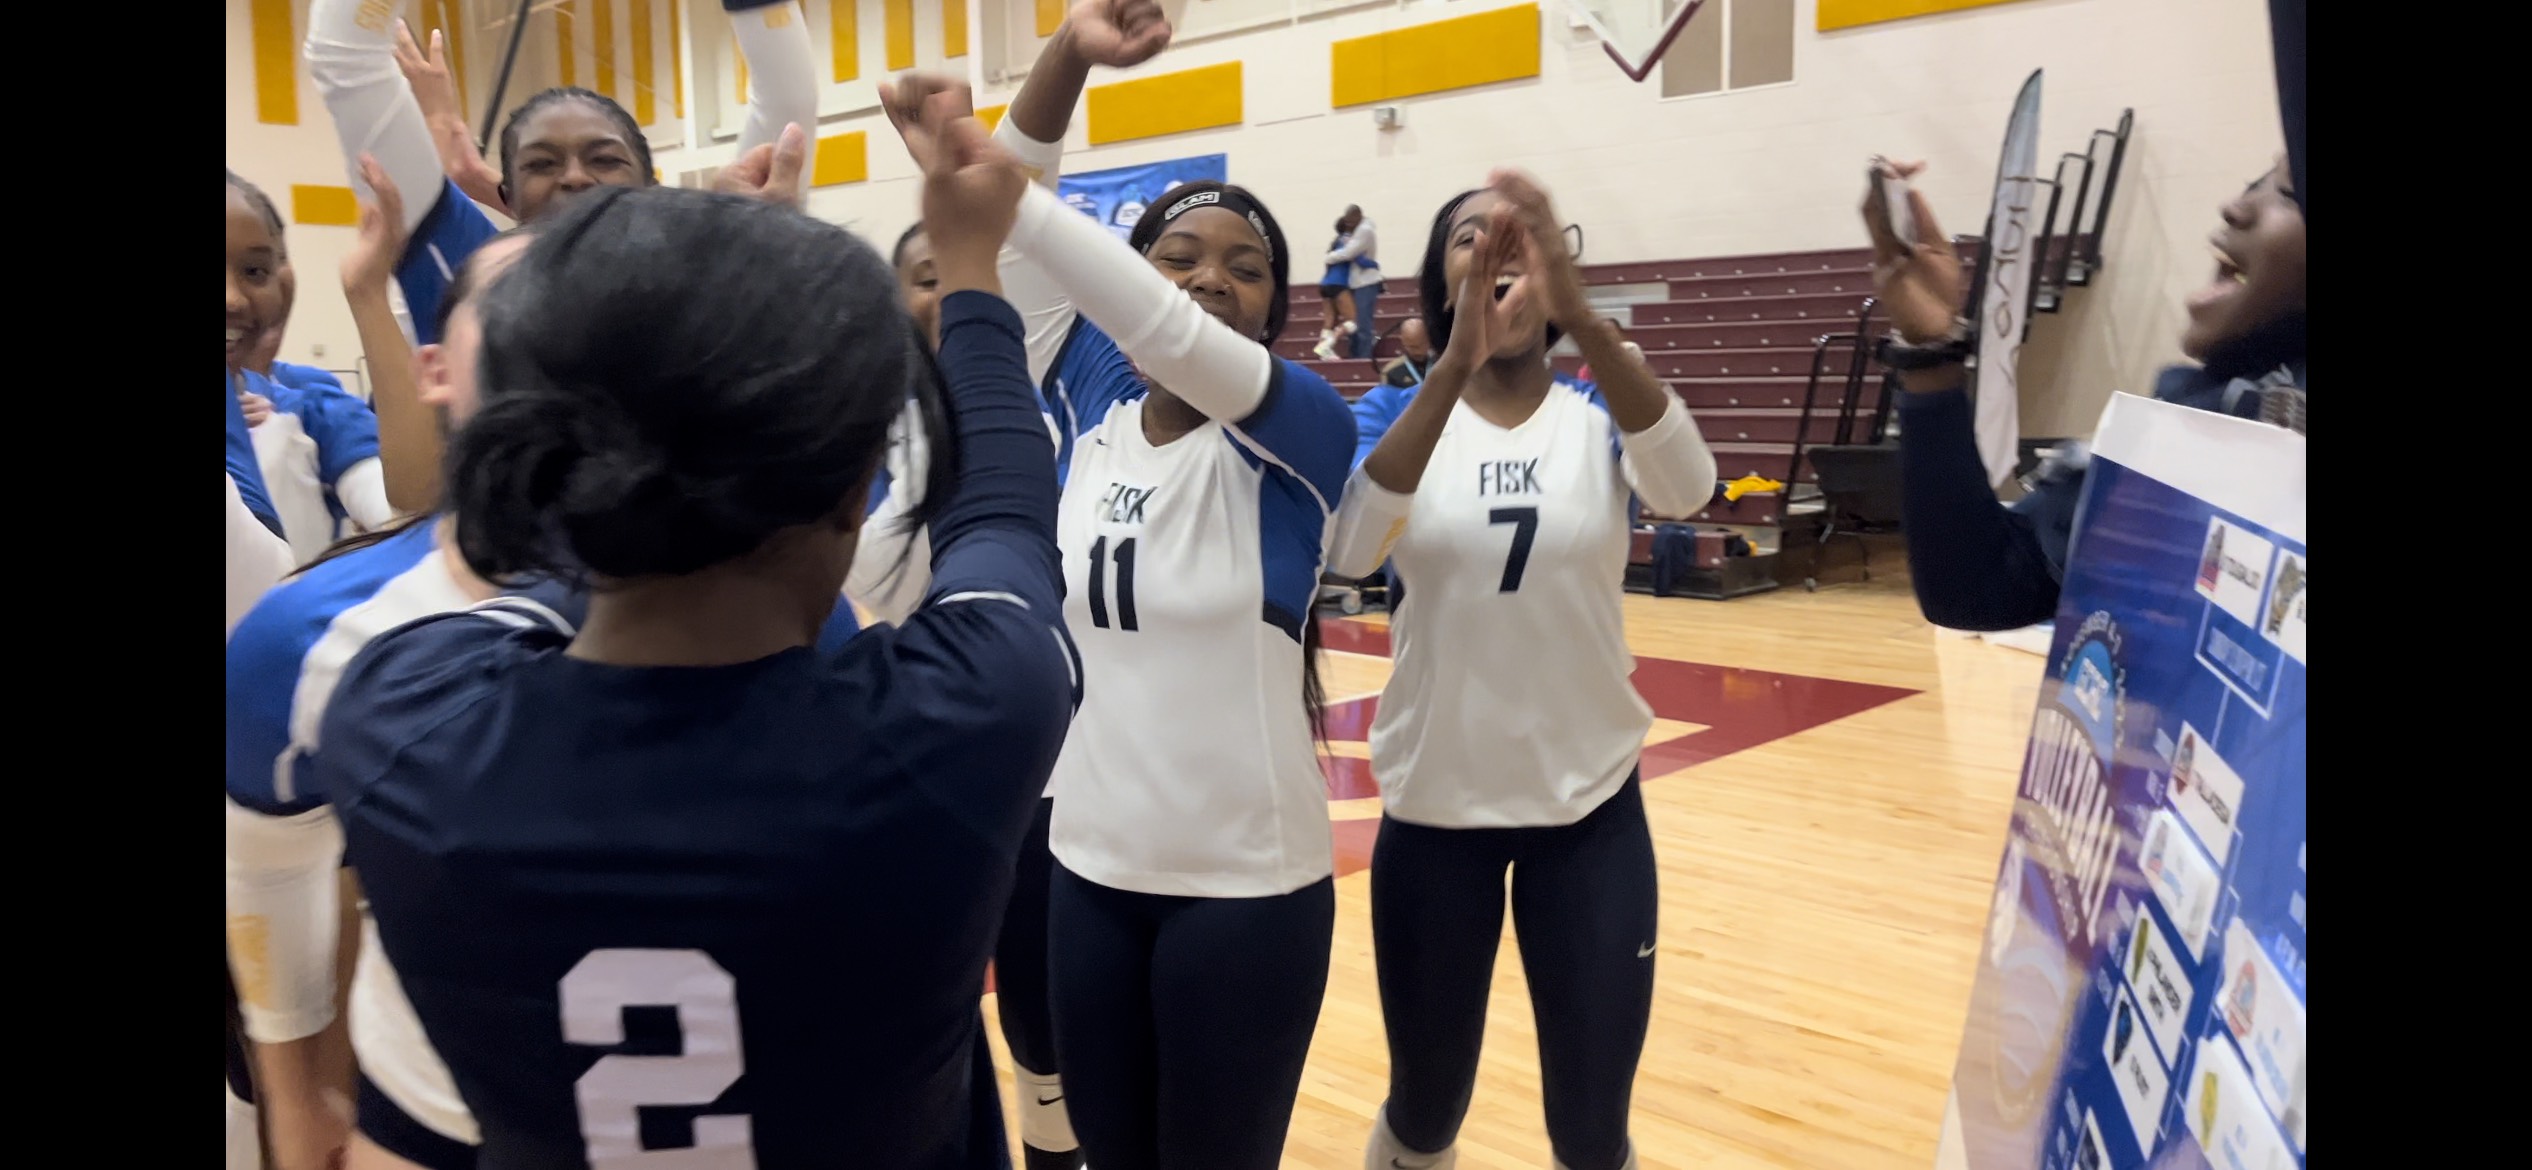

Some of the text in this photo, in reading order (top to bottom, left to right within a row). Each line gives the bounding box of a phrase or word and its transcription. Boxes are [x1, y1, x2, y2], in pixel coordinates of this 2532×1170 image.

[1097, 482, 1158, 524] FISK
[1480, 457, 1542, 497] FISK
[1088, 535, 1139, 632] 11
[1489, 506, 1539, 593] 7
[558, 948, 759, 1170] 2
